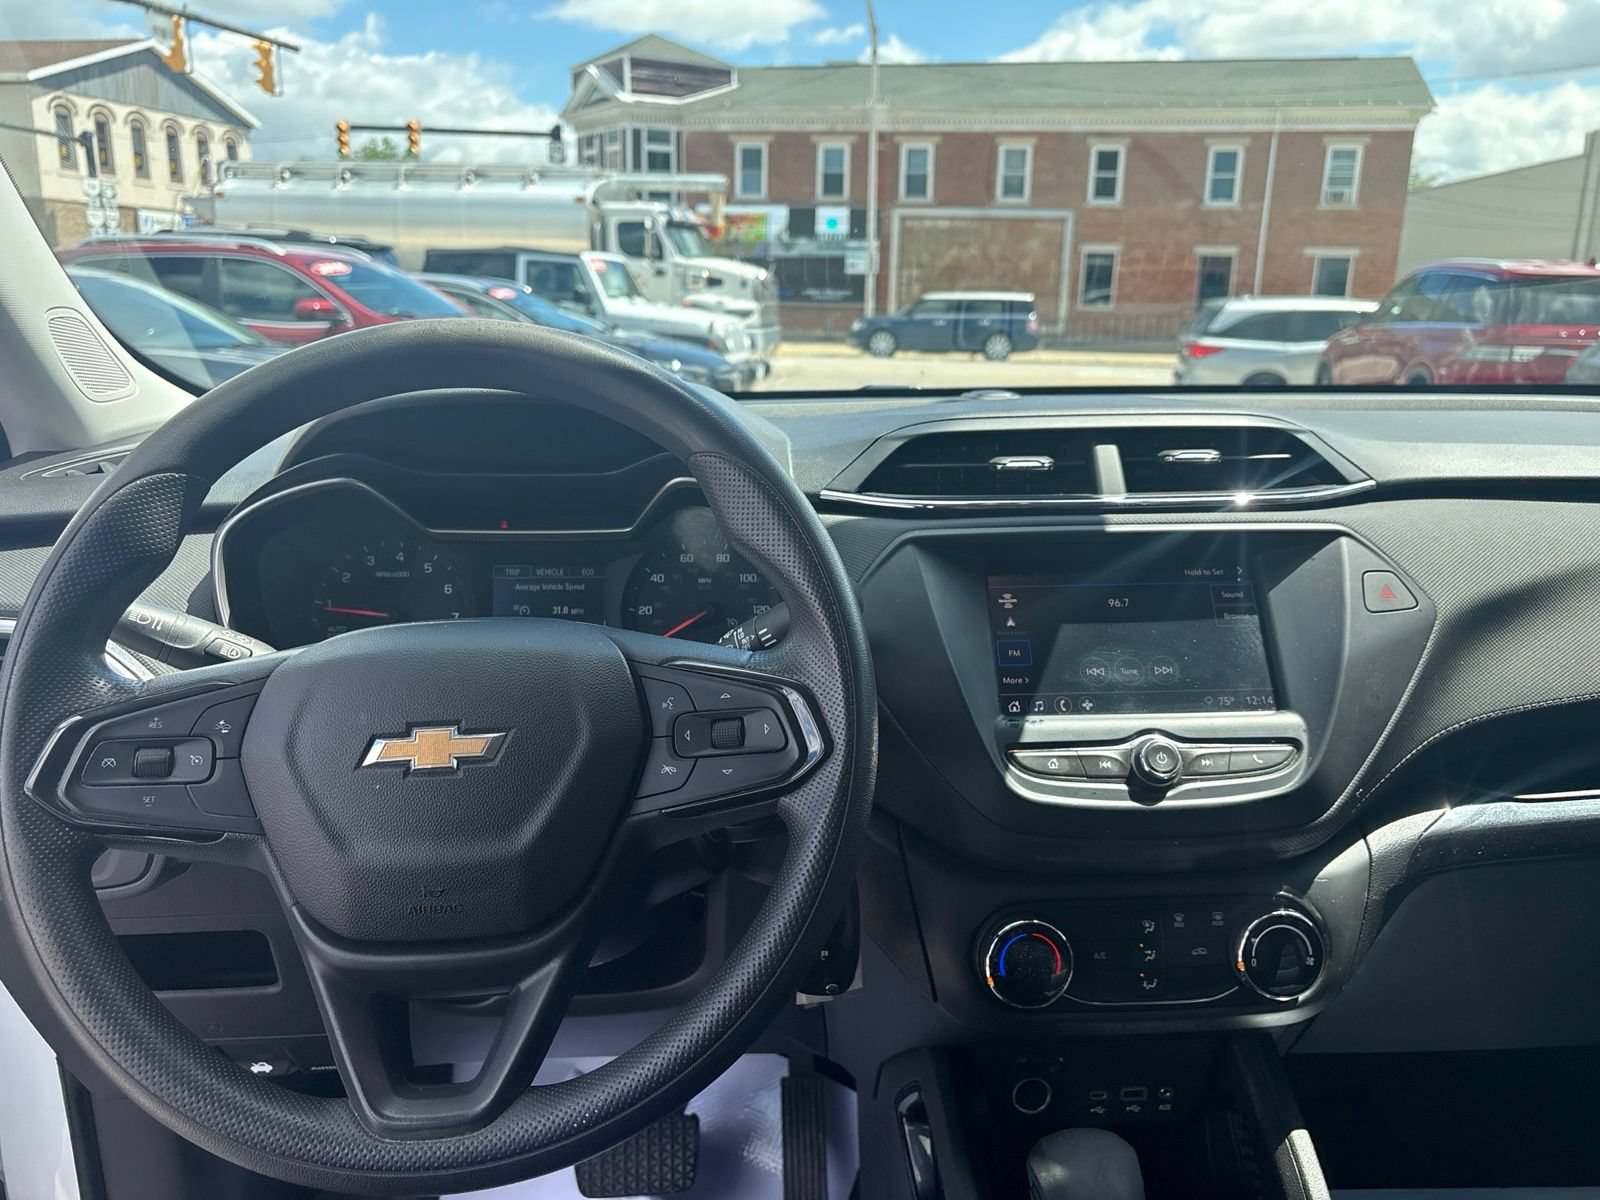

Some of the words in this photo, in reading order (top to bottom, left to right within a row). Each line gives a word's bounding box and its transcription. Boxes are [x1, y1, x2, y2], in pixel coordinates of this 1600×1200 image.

[366, 555, 375, 566] 3
[396, 552, 404, 562] 4
[680, 554, 694, 563] 60
[716, 554, 730, 563] 80
[424, 563, 432, 573] 5
[505, 568, 520, 576] TRIP
[536, 568, 564, 576] VEHICLE
[581, 567, 595, 576] ECO
[1183, 568, 1202, 576] Hold
[1203, 568, 1212, 576] to
[1212, 568, 1224, 576] Set
[342, 572, 350, 583] 2
[650, 574, 664, 583] 40
[739, 573, 758, 584] 100
[444, 584, 452, 594] 6
[515, 583, 541, 593] Average
[541, 583, 564, 591] Vehicle
[565, 583, 585, 593] Speed
[1107, 598, 1129, 608] 96.7
[552, 606, 568, 615] 31.0
[638, 605, 653, 616] 20
[1008, 649, 1021, 657] FM
[1120, 667, 1139, 675] Tune
[1002, 676, 1023, 684] More
[1246, 695, 1274, 705] 12:14
[148, 721, 162, 729] RES
[1158, 1103, 1172, 1111] AUX
